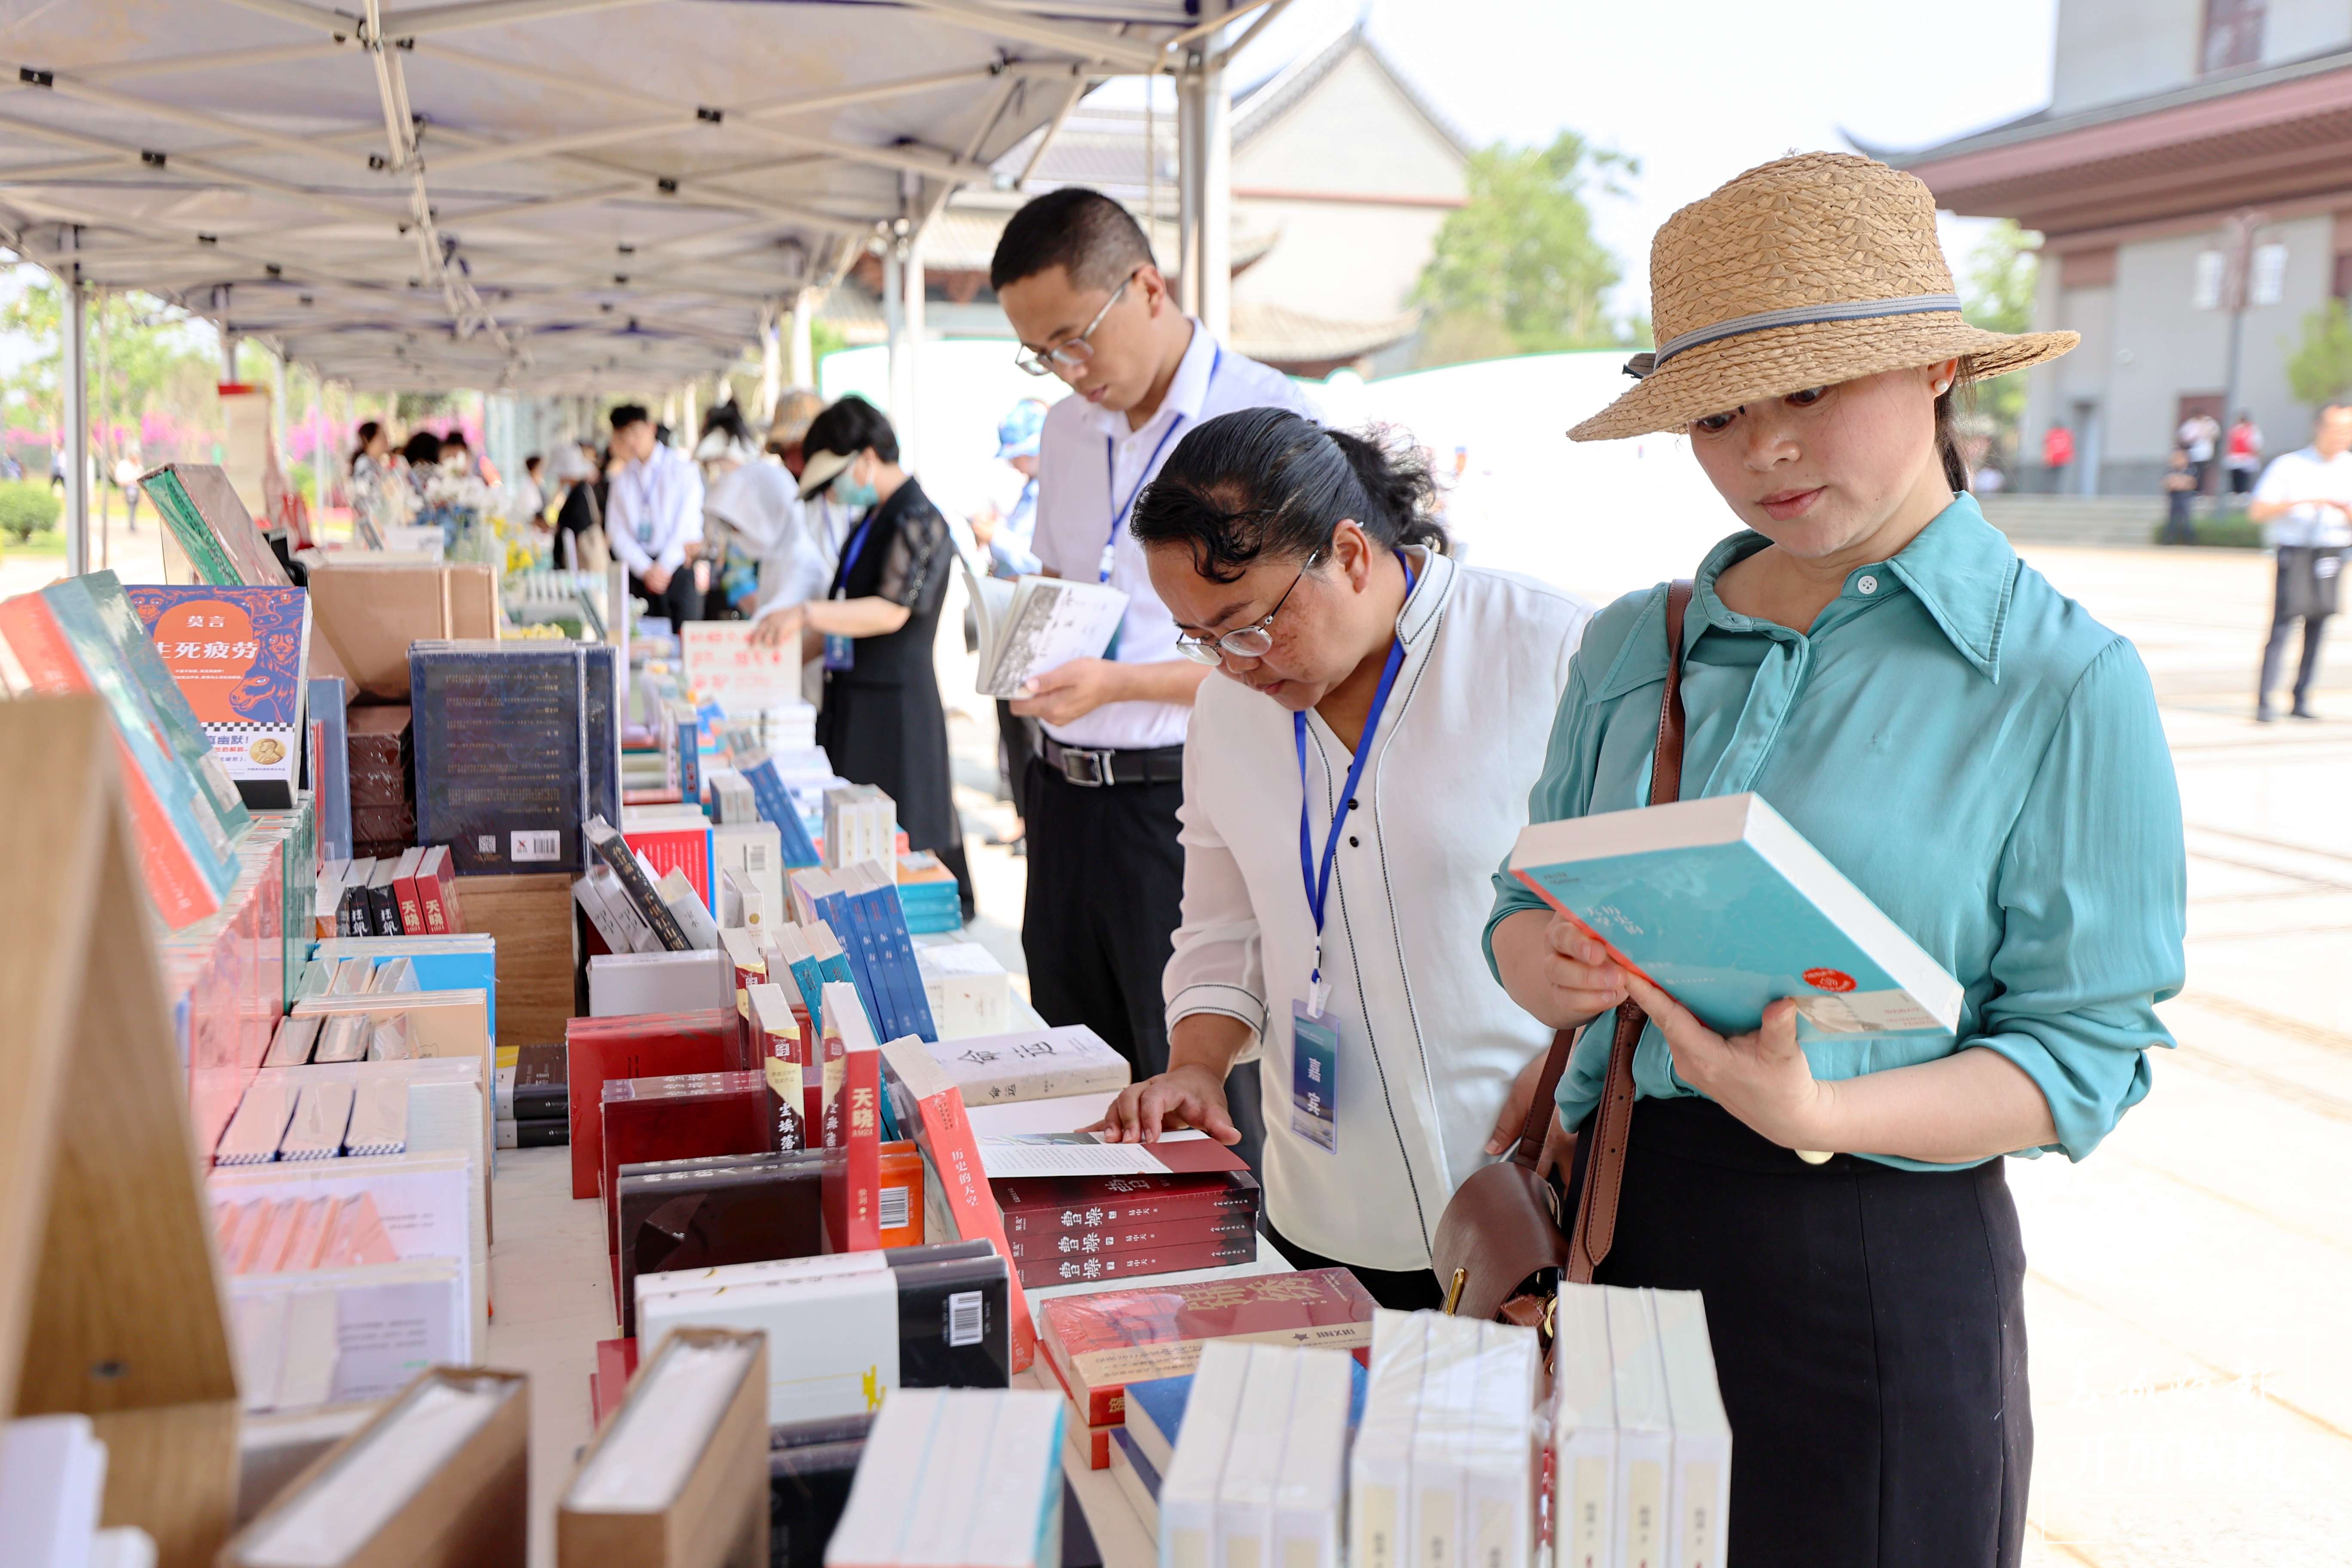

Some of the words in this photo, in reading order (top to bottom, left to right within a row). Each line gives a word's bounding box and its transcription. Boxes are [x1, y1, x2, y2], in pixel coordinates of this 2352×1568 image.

[187, 616, 225, 628] 莫言
[155, 641, 258, 659] 生死疲劳
[401, 900, 420, 926] 天晓
[426, 899, 444, 925] 天晓
[958, 1041, 1056, 1064] 命运
[990, 1084, 1016, 1099] 命运
[1307, 1057, 1321, 1116] 嘉宾
[852, 1087, 874, 1129] 天晓
[852, 1129, 873, 1137] 1921
[951, 1148, 979, 1207] 历史的天空
[1061, 1207, 1103, 1227] 曹操
[1058, 1232, 1100, 1253] 曹操
[1059, 1257, 1101, 1279] 曹操
[1127, 1259, 1148, 1267] 易中天
[1180, 1277, 1323, 1311] 锦绣
